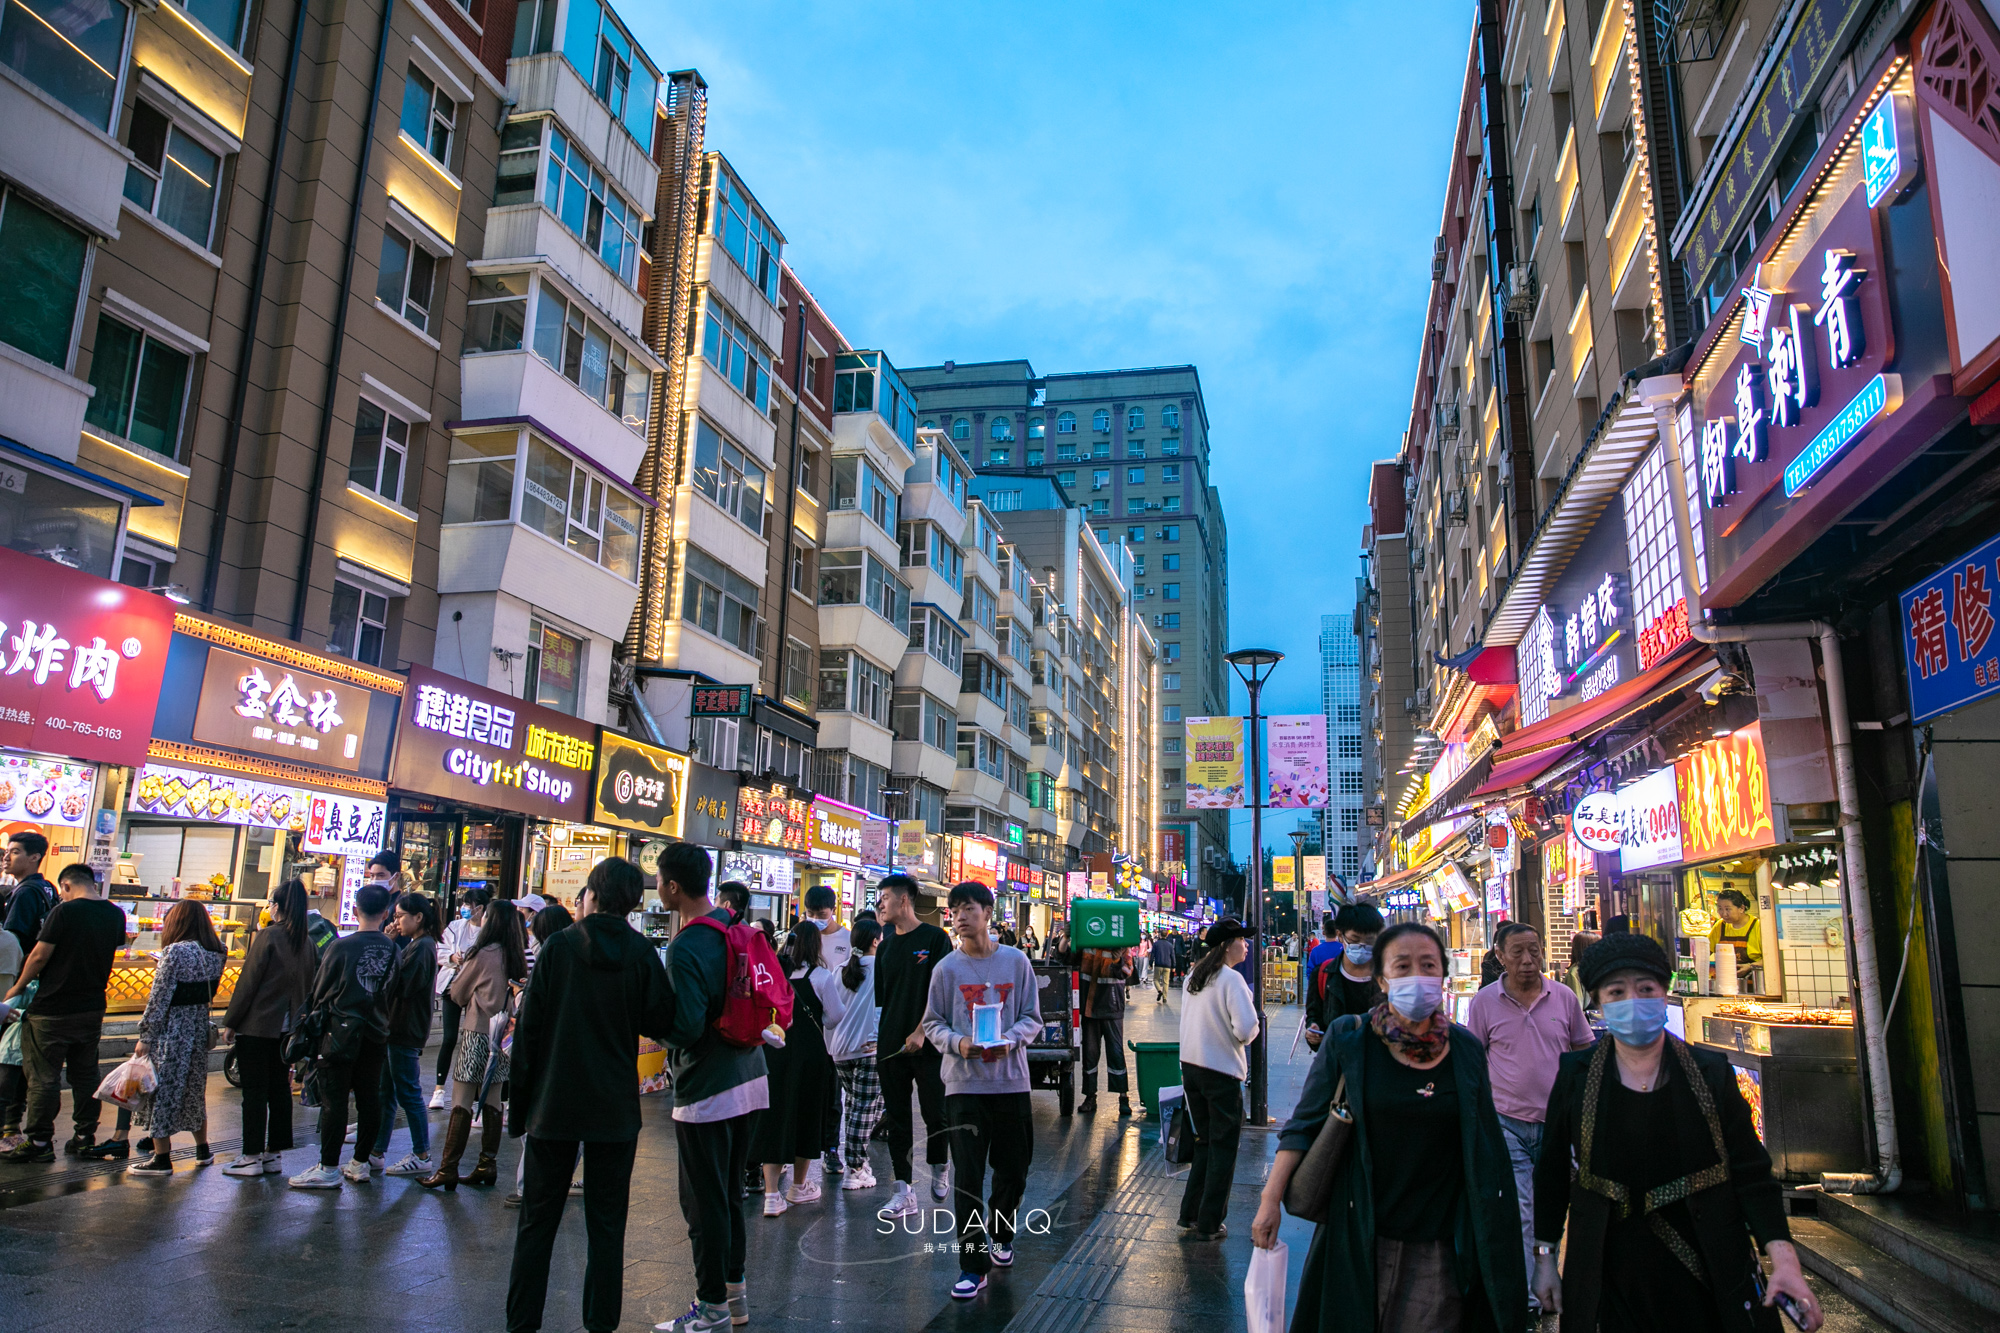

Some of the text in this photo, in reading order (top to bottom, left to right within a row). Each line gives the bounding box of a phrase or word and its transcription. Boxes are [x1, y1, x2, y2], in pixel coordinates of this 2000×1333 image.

[1701, 250, 1852, 509] 御尊刺青
[1909, 556, 2000, 680] 精修
[45, 716, 122, 740] 400-765-6163
[525, 723, 595, 771] 城市超市
[1578, 804, 1620, 825] 品臭
